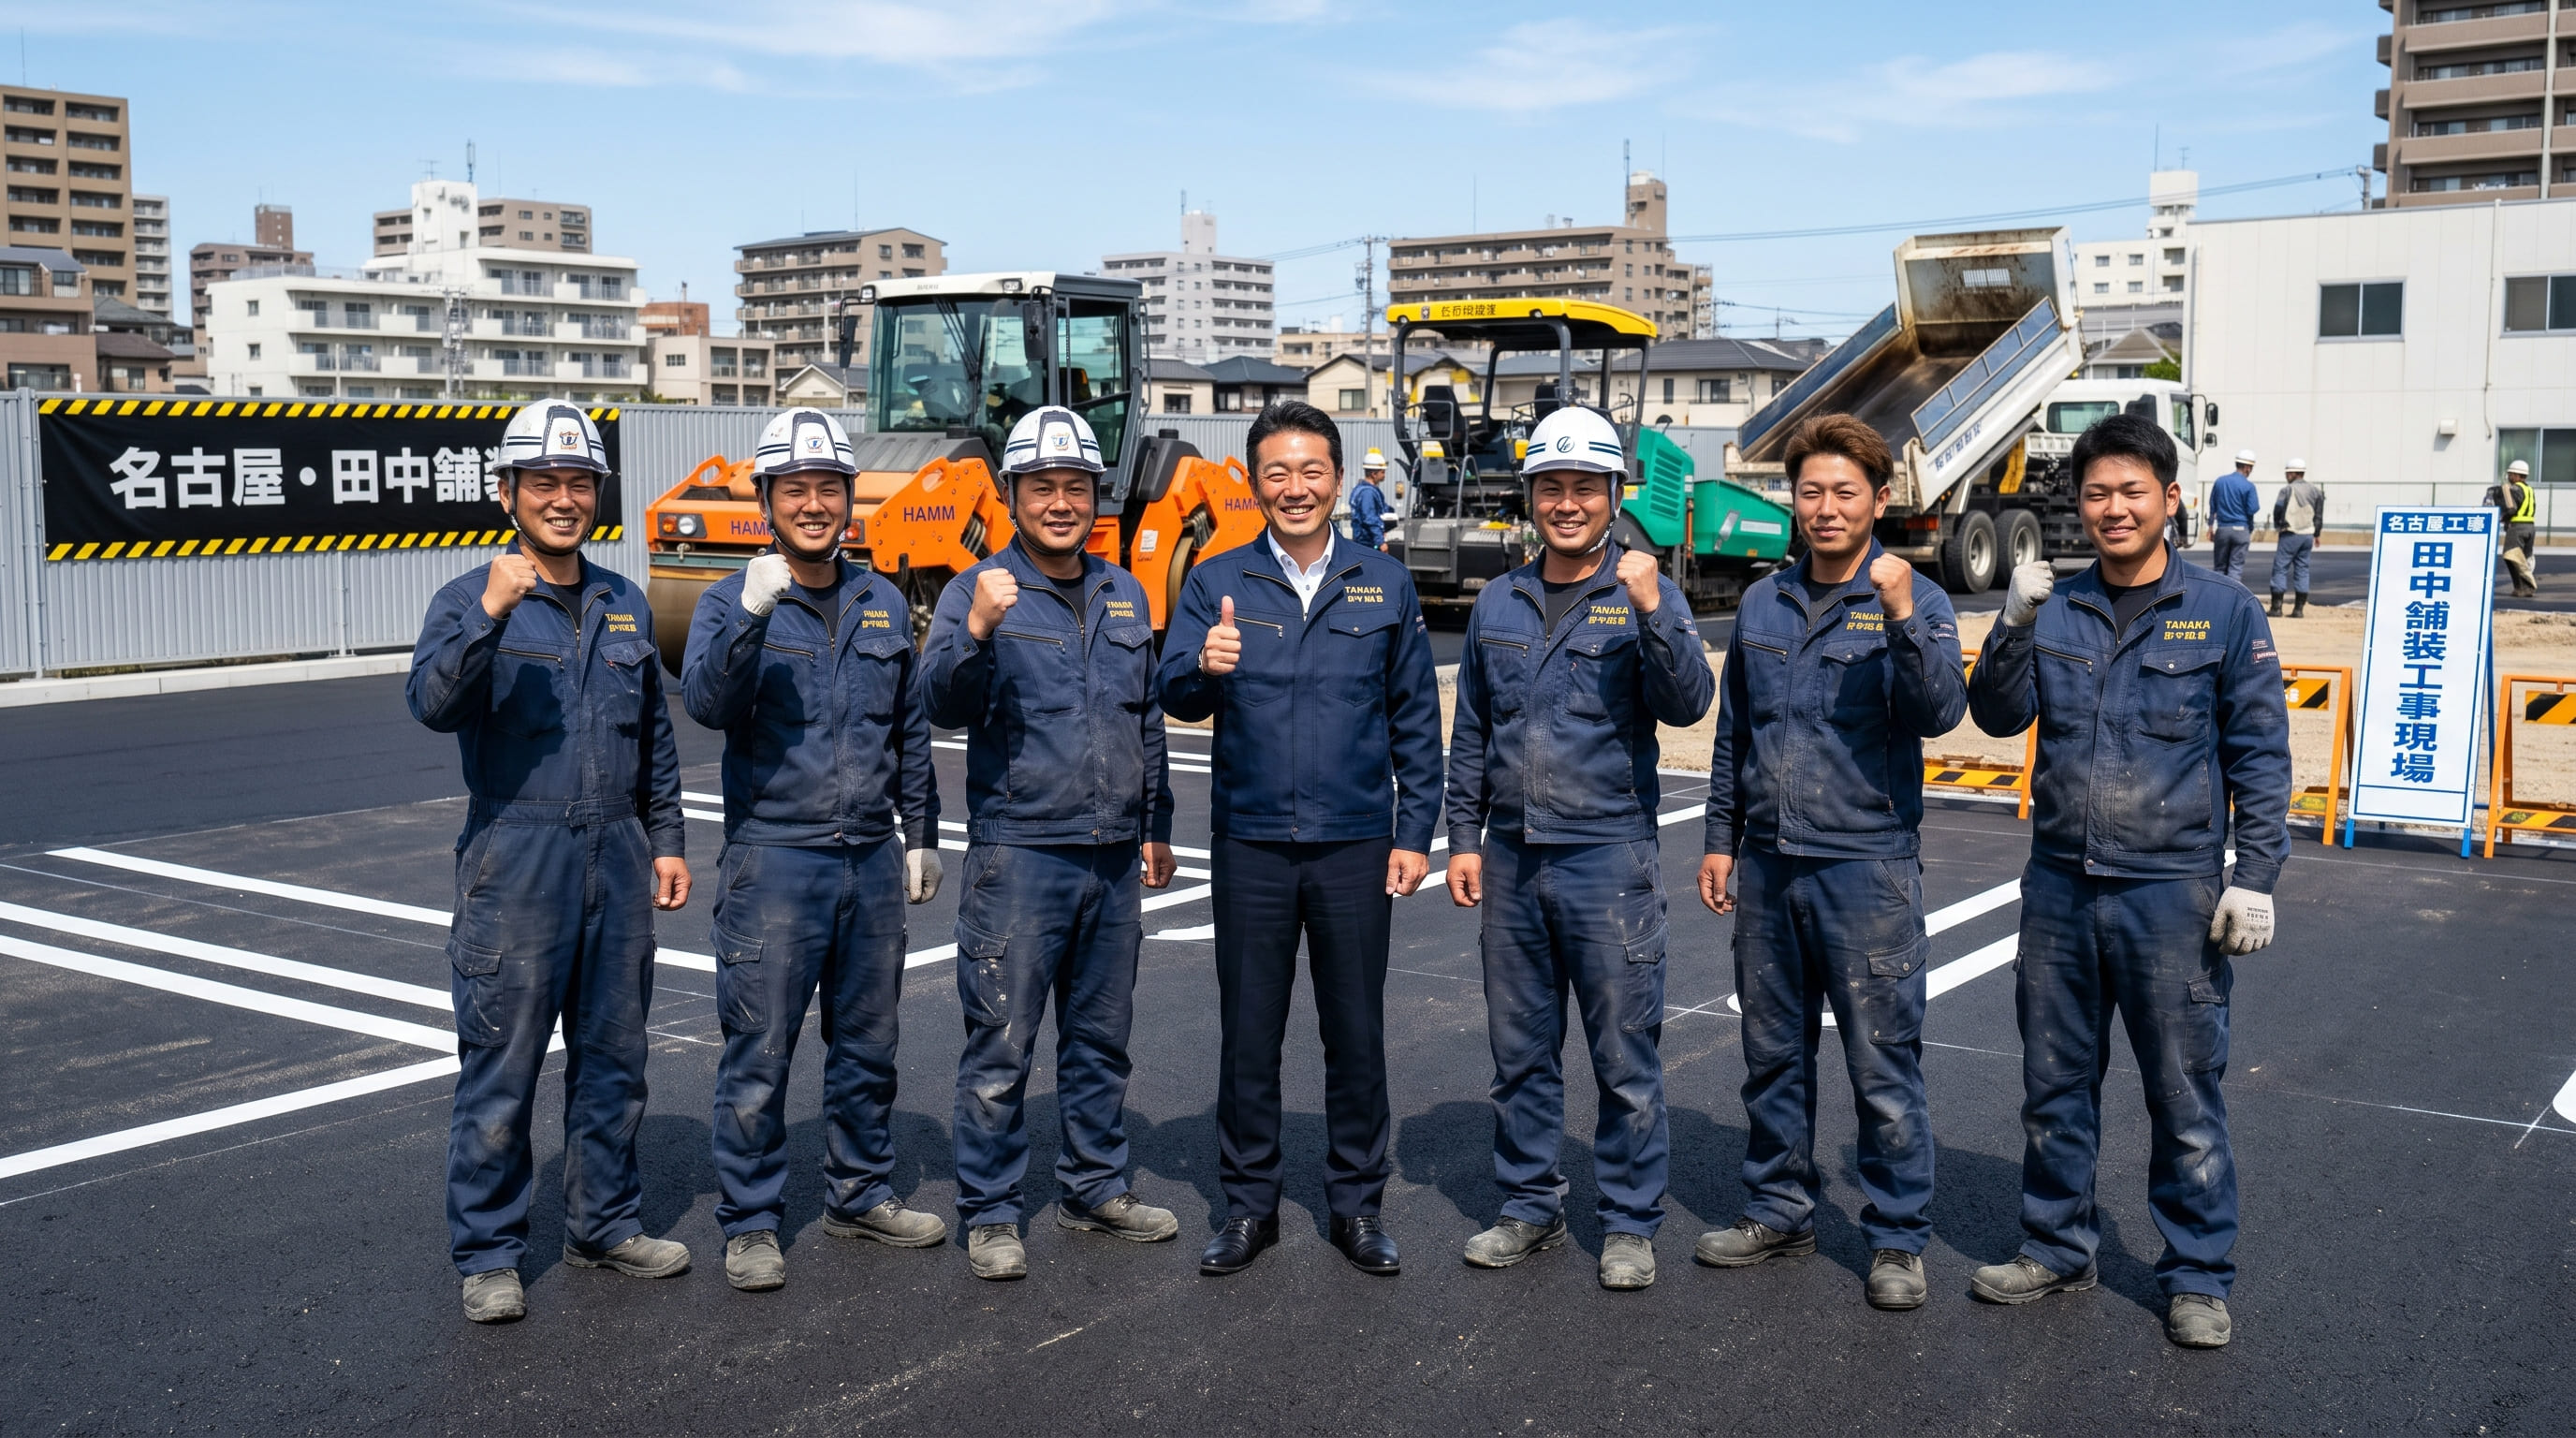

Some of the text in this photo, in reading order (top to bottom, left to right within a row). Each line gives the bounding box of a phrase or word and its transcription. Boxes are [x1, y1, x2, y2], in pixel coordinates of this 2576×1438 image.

[903, 506, 955, 521] HAMM
[2165, 620, 2211, 629] TANAKA
[2390, 541, 2453, 784] 田中舗装工事現場
